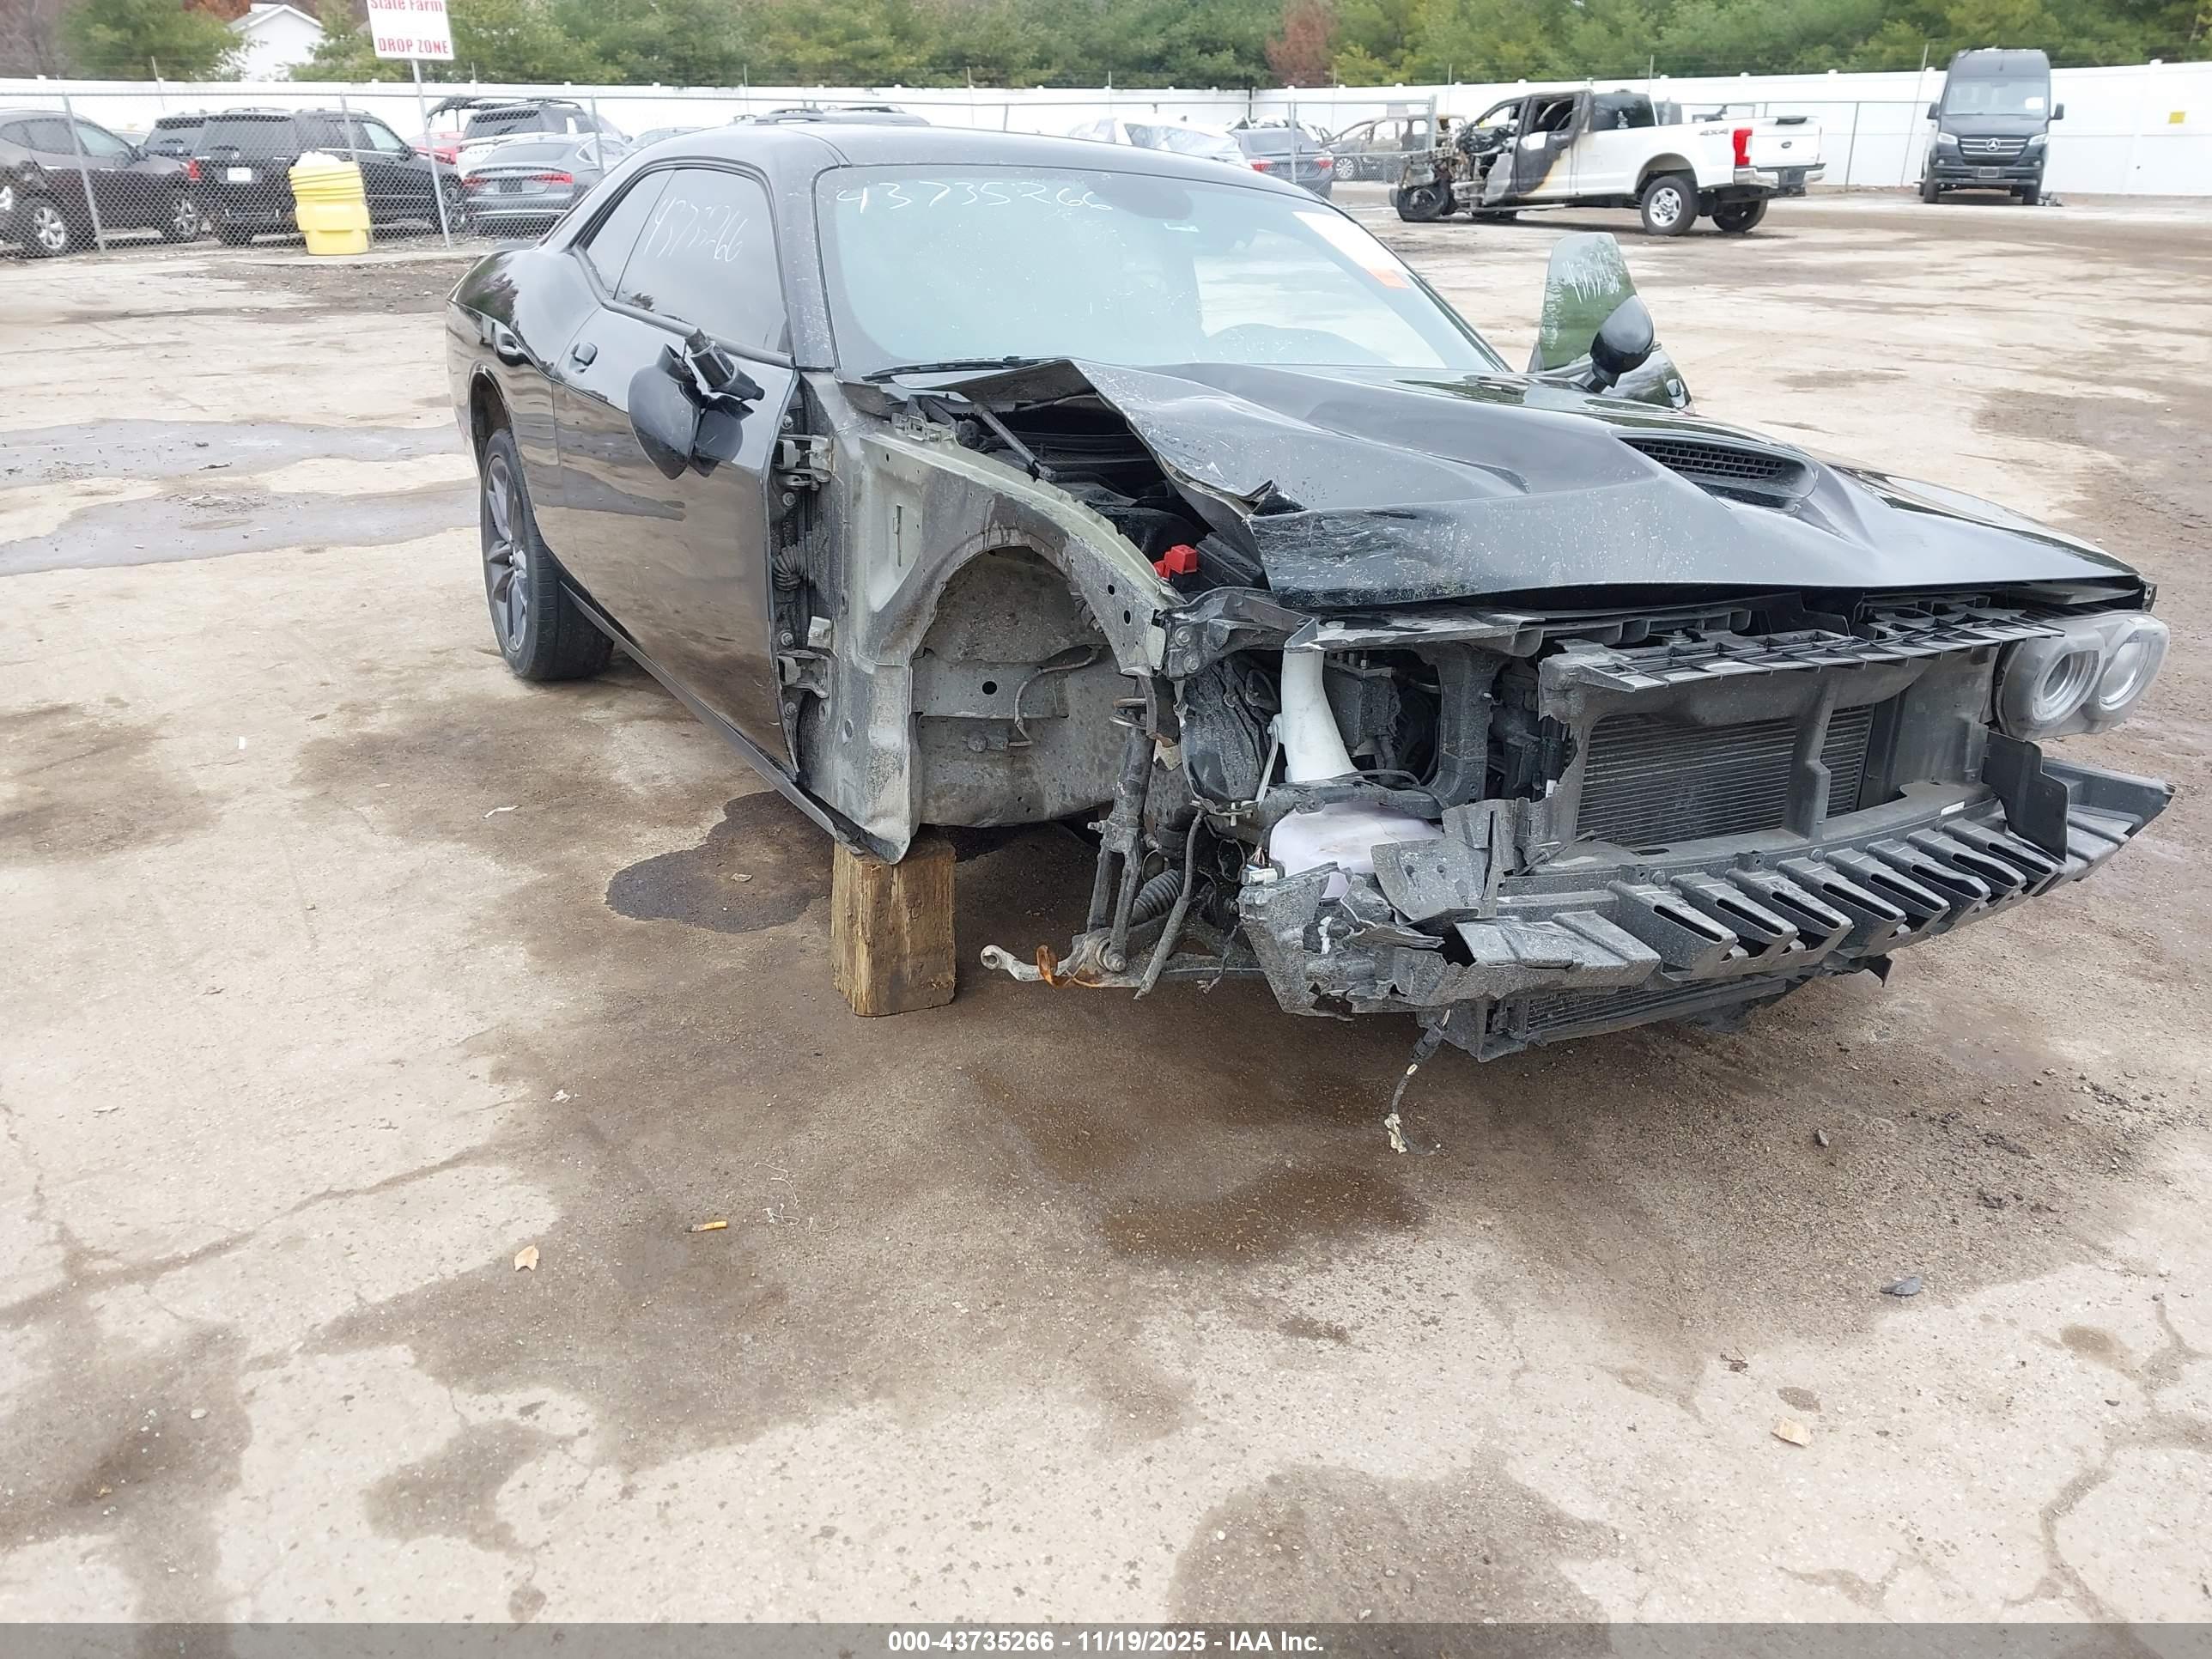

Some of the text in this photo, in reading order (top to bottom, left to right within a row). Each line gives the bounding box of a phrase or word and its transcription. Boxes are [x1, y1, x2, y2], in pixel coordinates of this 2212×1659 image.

[370, 0, 406, 10] State
[378, 38, 449, 54] DROP ZONE
[836, 180, 1114, 214] 43735266
